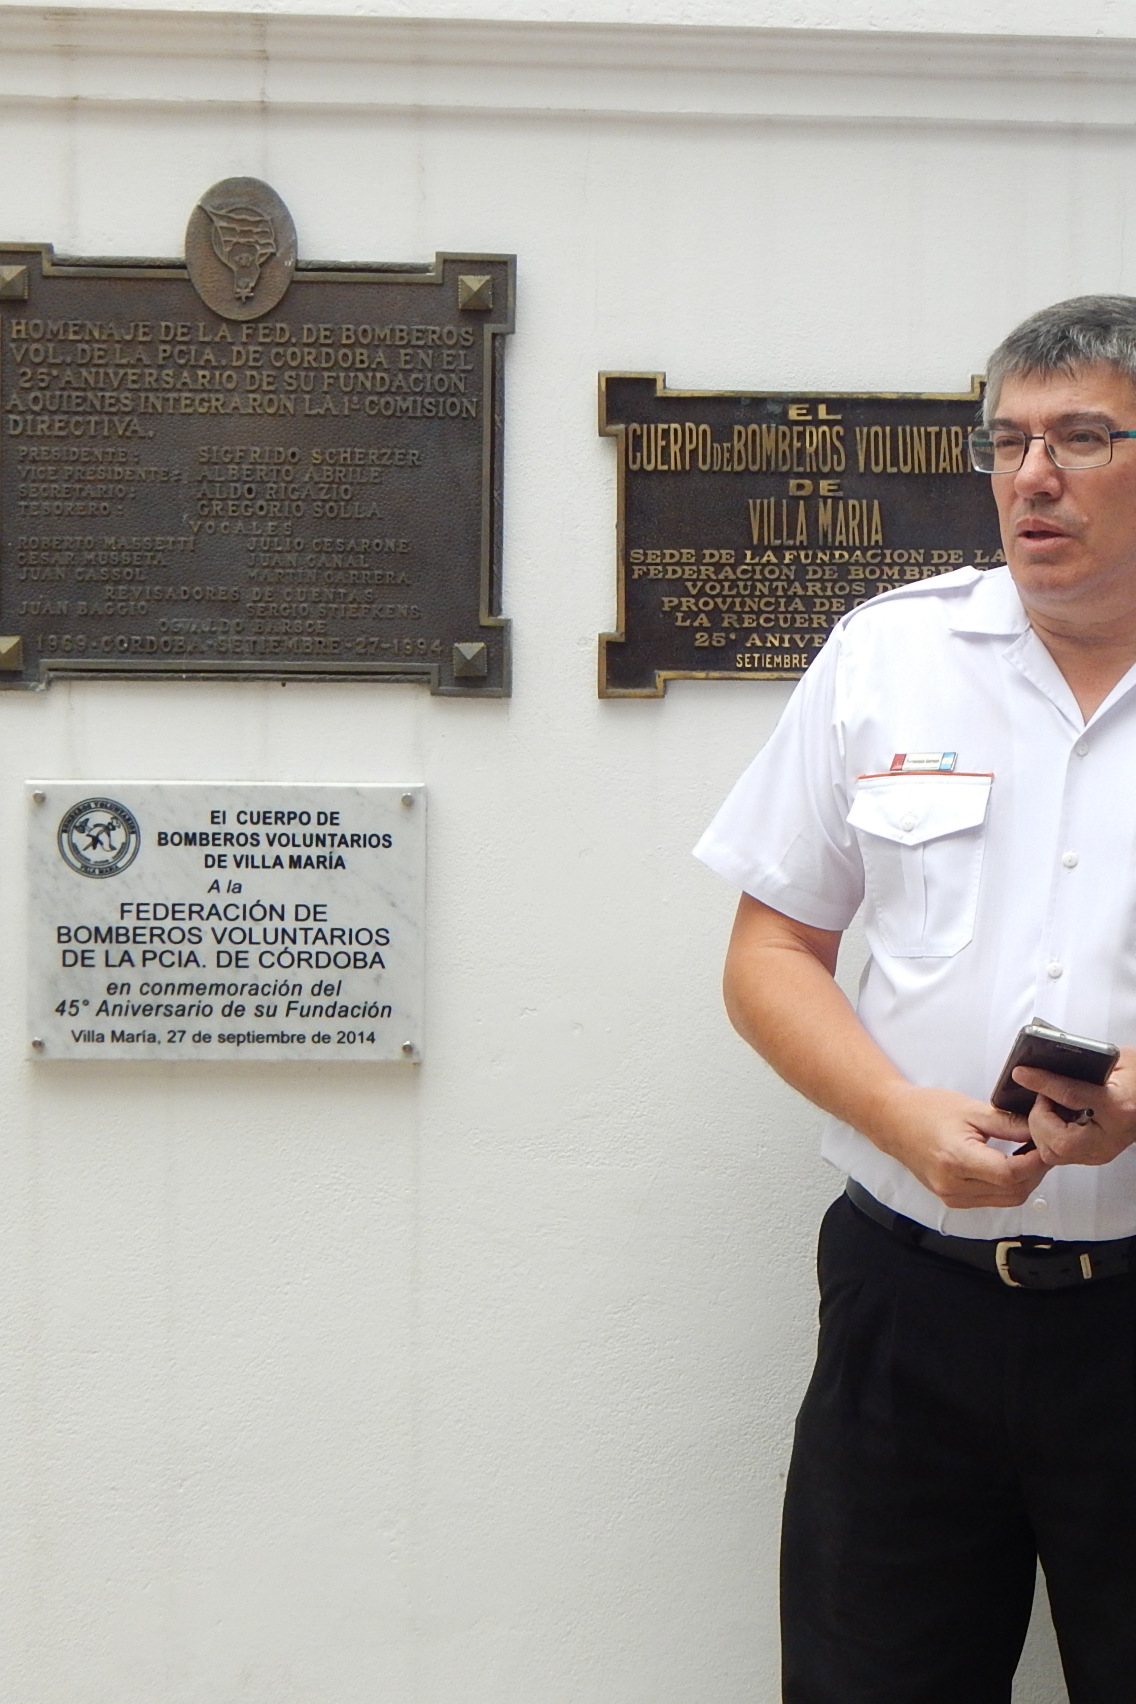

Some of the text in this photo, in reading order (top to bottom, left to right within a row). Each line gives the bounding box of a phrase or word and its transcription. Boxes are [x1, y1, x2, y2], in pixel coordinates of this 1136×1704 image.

[11, 319, 474, 346] HOMENAJE DE LA FED. DE BOMBEROS
[9, 343, 474, 371] VOL. DE LA PCIA. DE CORDOBA EN EL
[59, 368, 238, 390] ANIVERSARIO
[245, 370, 277, 391] DE
[283, 371, 315, 391] SU
[322, 371, 466, 393] FUNDACION
[5, 391, 478, 418] A QUIENES INTEGRARON LA COMISION
[788, 404, 842, 420] EL
[8, 414, 155, 438] DIRECTIVA.
[200, 446, 422, 467] SIGFRIDO SCHERZER
[628, 424, 712, 472] CUERPO
[713, 443, 732, 470] DE
[733, 424, 845, 473] BOMBEROS
[199, 466, 383, 484] ALBERTO ABRILE
[198, 483, 353, 500] ALDO RIGAZIO
[788, 480, 843, 496] DE
[199, 501, 382, 519] GREGORIO SOLLA
[190, 521, 292, 536] VOCALES
[749, 498, 883, 546] VILLA MARIA
[630, 549, 964, 564] SEDE DE LA FUNDACION DE
[631, 565, 838, 580] FEDERACION DE
[685, 581, 865, 596] VOLUNTARIOS
[662, 597, 807, 612] PROVINCIA
[812, 597, 846, 612] DE
[675, 614, 711, 628] LA
[736, 654, 809, 668] SETIEMBRE
[236, 811, 312, 826] CUERPO
[317, 812, 340, 826] DE
[157, 832, 392, 848] BOMBEROS VOLUNTARIOS
[205, 851, 346, 869] DE VILLA MARÍA
[207, 879, 242, 894] A la
[121, 899, 327, 922] FEDERACIÓN DE
[57, 926, 390, 946] BOMBEROS VOLUNTARIOS
[62, 948, 385, 969] DE LA PCIA. DE CÓRDOBA
[106, 979, 341, 997] en conmemoración del
[96, 1000, 212, 1018] Aniversario
[221, 1001, 245, 1018] de
[254, 1005, 277, 1018] su
[285, 1001, 392, 1019] Fundación
[71, 1030, 375, 1049] Villa María, 27 de septiembre de 2014
